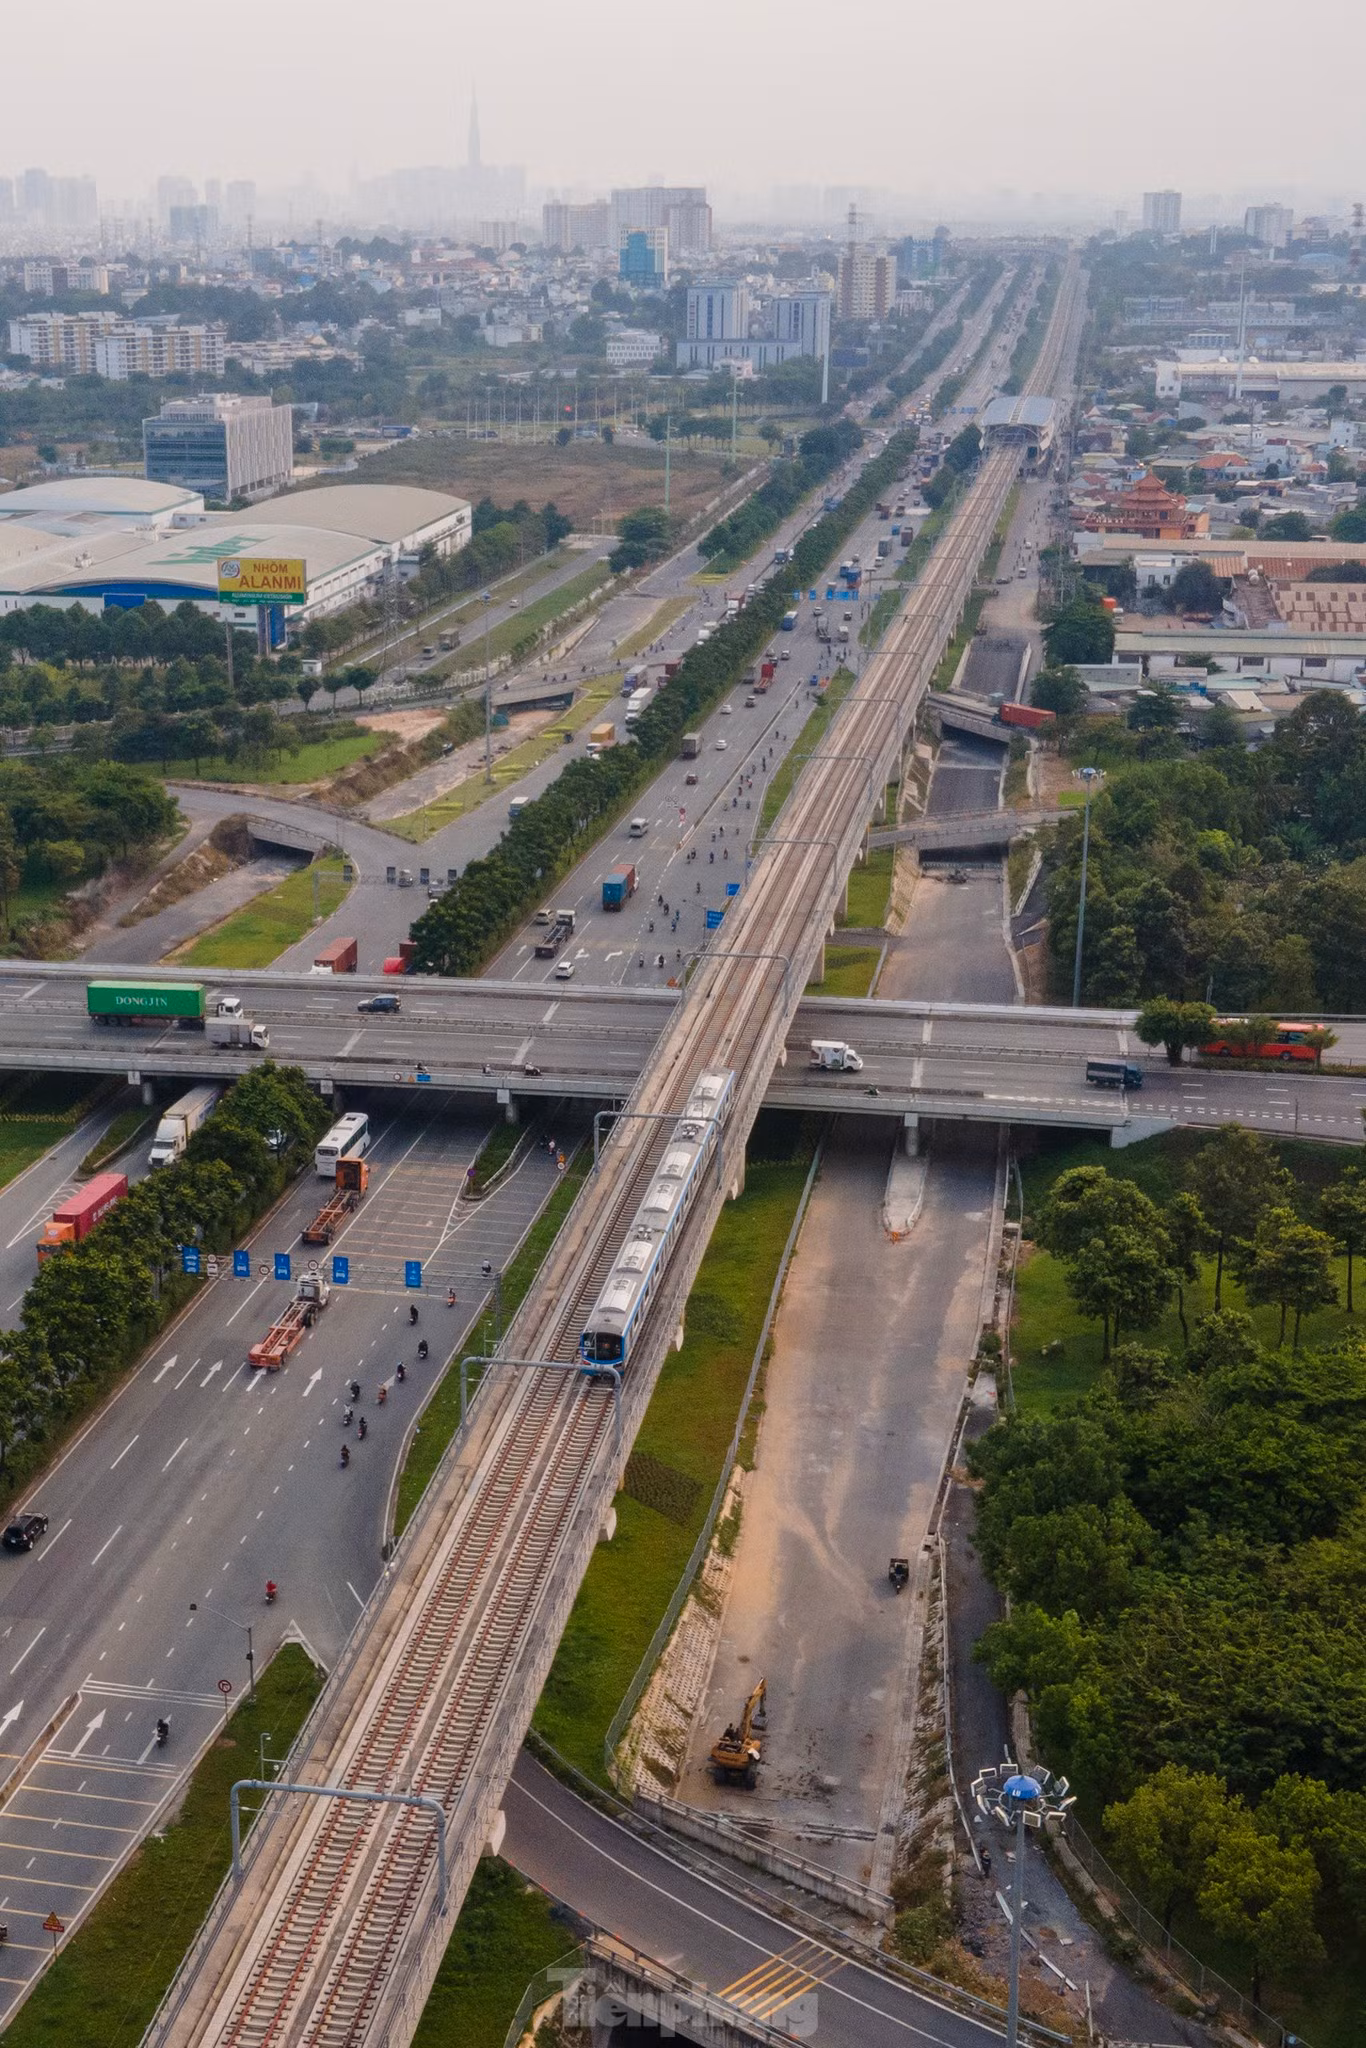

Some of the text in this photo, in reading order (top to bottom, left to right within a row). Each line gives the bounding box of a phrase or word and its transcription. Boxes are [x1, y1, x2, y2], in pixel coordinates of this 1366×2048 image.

[253, 561, 288, 573] NHÔM
[239, 575, 301, 589] ALANMI
[115, 995, 168, 1007] DONGJIN
